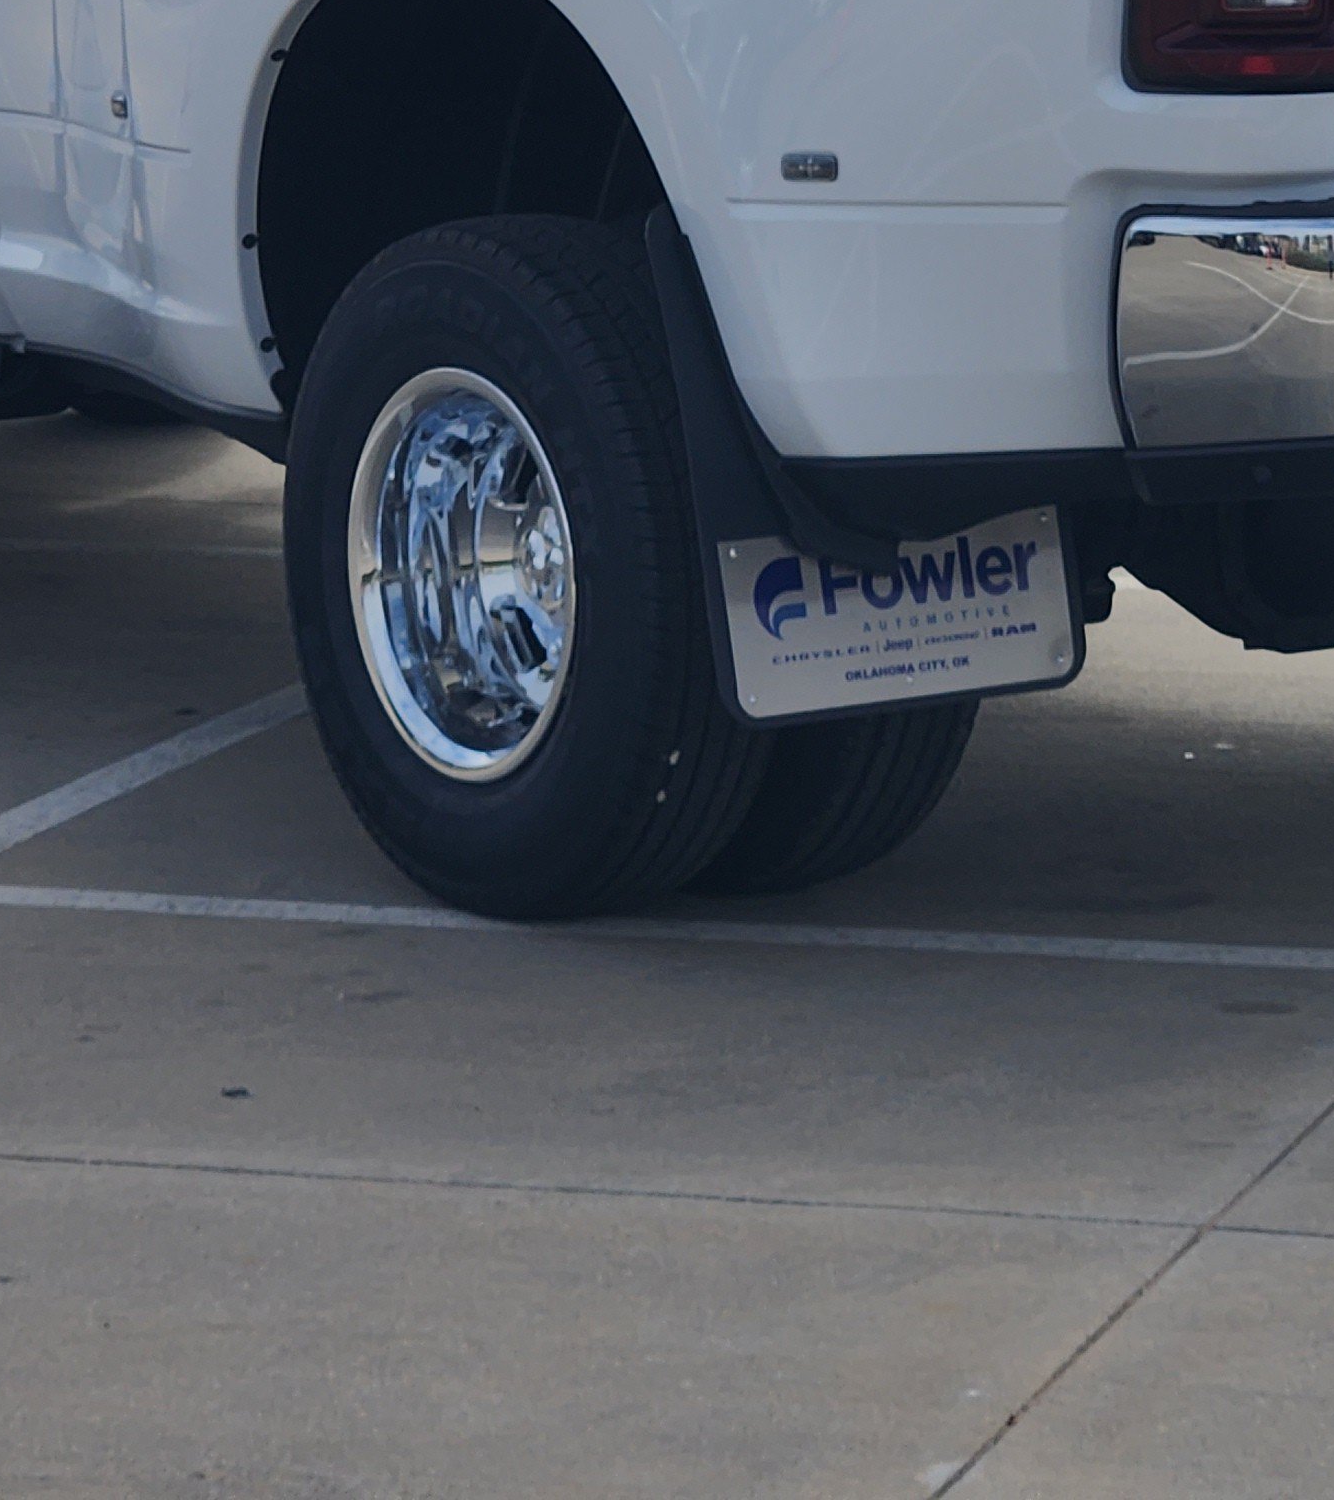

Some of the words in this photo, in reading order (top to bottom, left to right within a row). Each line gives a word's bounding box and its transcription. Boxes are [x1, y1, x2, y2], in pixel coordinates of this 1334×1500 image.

[817, 535, 1036, 615] Fowler
[862, 603, 1010, 633] AUTOMOTIVE
[845, 663, 915, 682] OKLAHOMA
